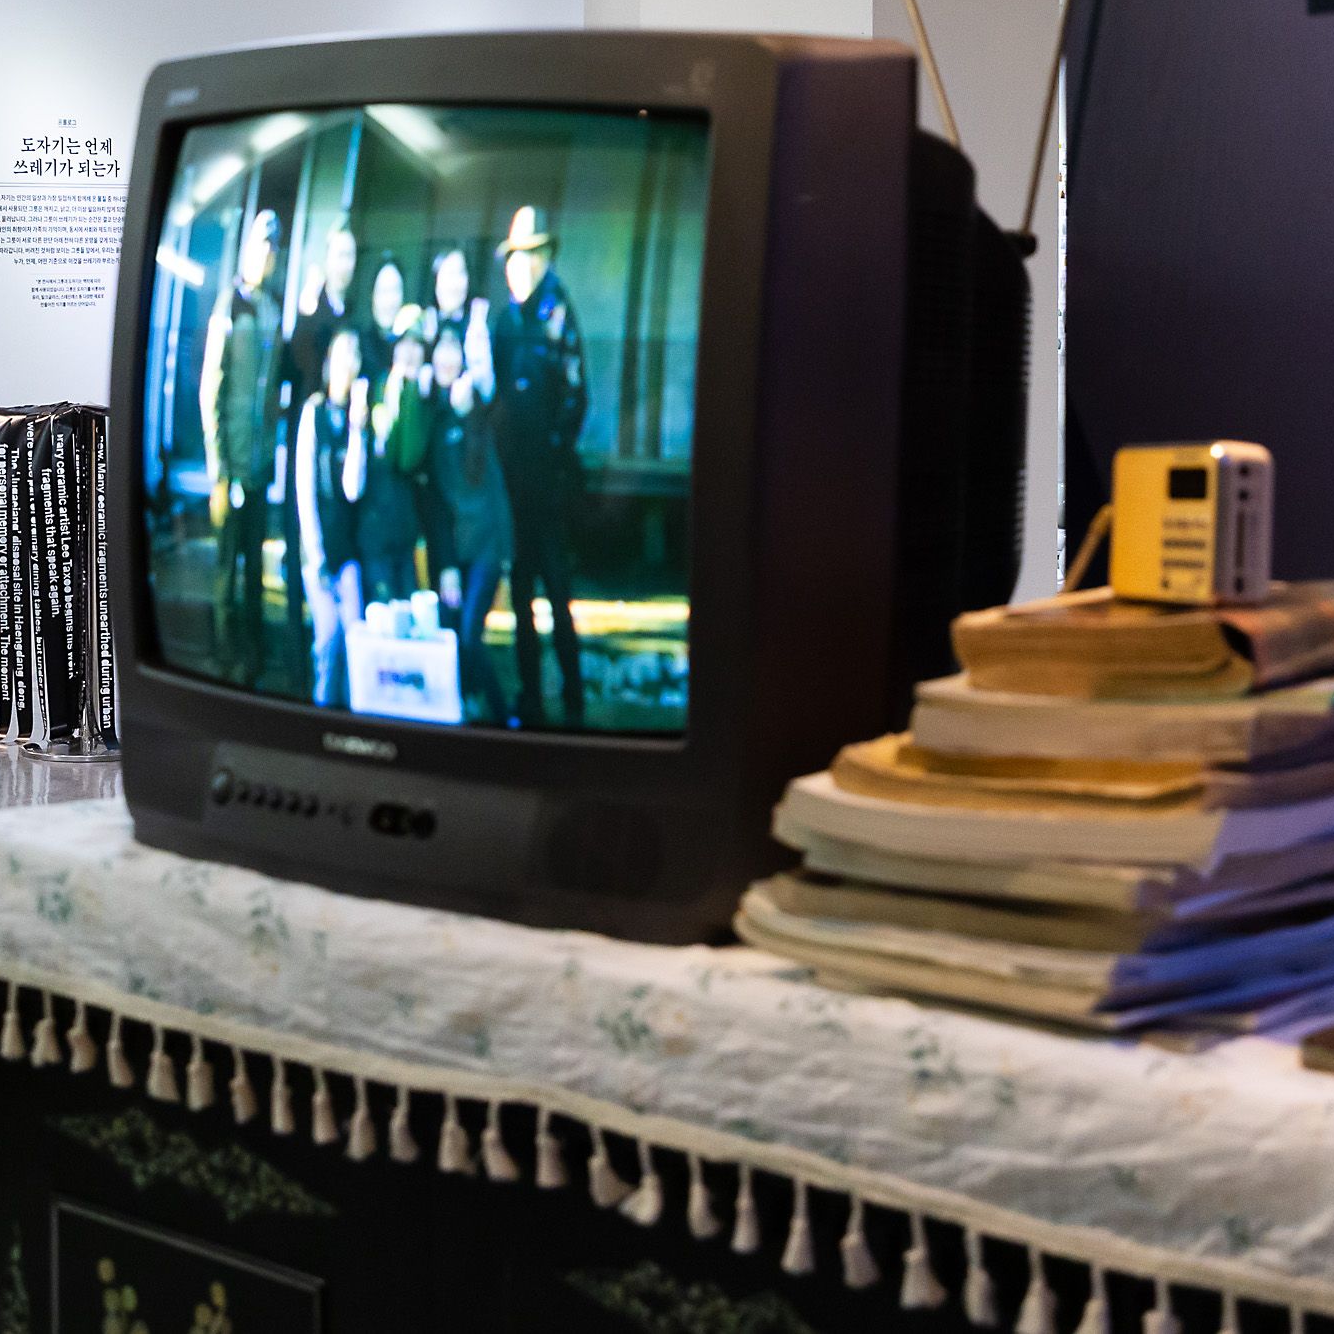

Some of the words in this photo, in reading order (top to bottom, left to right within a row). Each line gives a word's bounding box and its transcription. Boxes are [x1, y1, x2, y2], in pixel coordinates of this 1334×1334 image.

[21, 136, 81, 155] 도자기는
[85, 137, 112, 156] 언제
[13, 158, 73, 177] 쓰레기가
[78, 159, 120, 178] 되는가
[0, 443, 8, 460] for
[57, 461, 69, 506] ceramic
[96, 463, 107, 493] Many
[41, 468, 55, 525] fragments
[59, 507, 71, 536] artist
[97, 495, 108, 540] ceramic
[45, 526, 57, 548] that
[61, 537, 71, 558] Lee
[0, 556, 7, 568] or
[12, 536, 22, 585] disposal
[46, 550, 58, 584] speak
[62, 559, 73, 594] Taxoo
[97, 542, 109, 598] fragments
[0, 569, 9, 633] attachment.
[13, 587, 23, 602] site
[14, 604, 23, 614] in
[49, 585, 61, 618] again.
[63, 595, 73, 632] begins
[99, 600, 112, 658] unearthed
[0, 634, 11, 656] The
[13, 616, 25, 677] Haengdang
[35, 636, 43, 654] but
[1, 657, 11, 701] moment
[100, 659, 112, 694] during
[17, 680, 26, 711] dong,
[102, 696, 113, 728] urban
